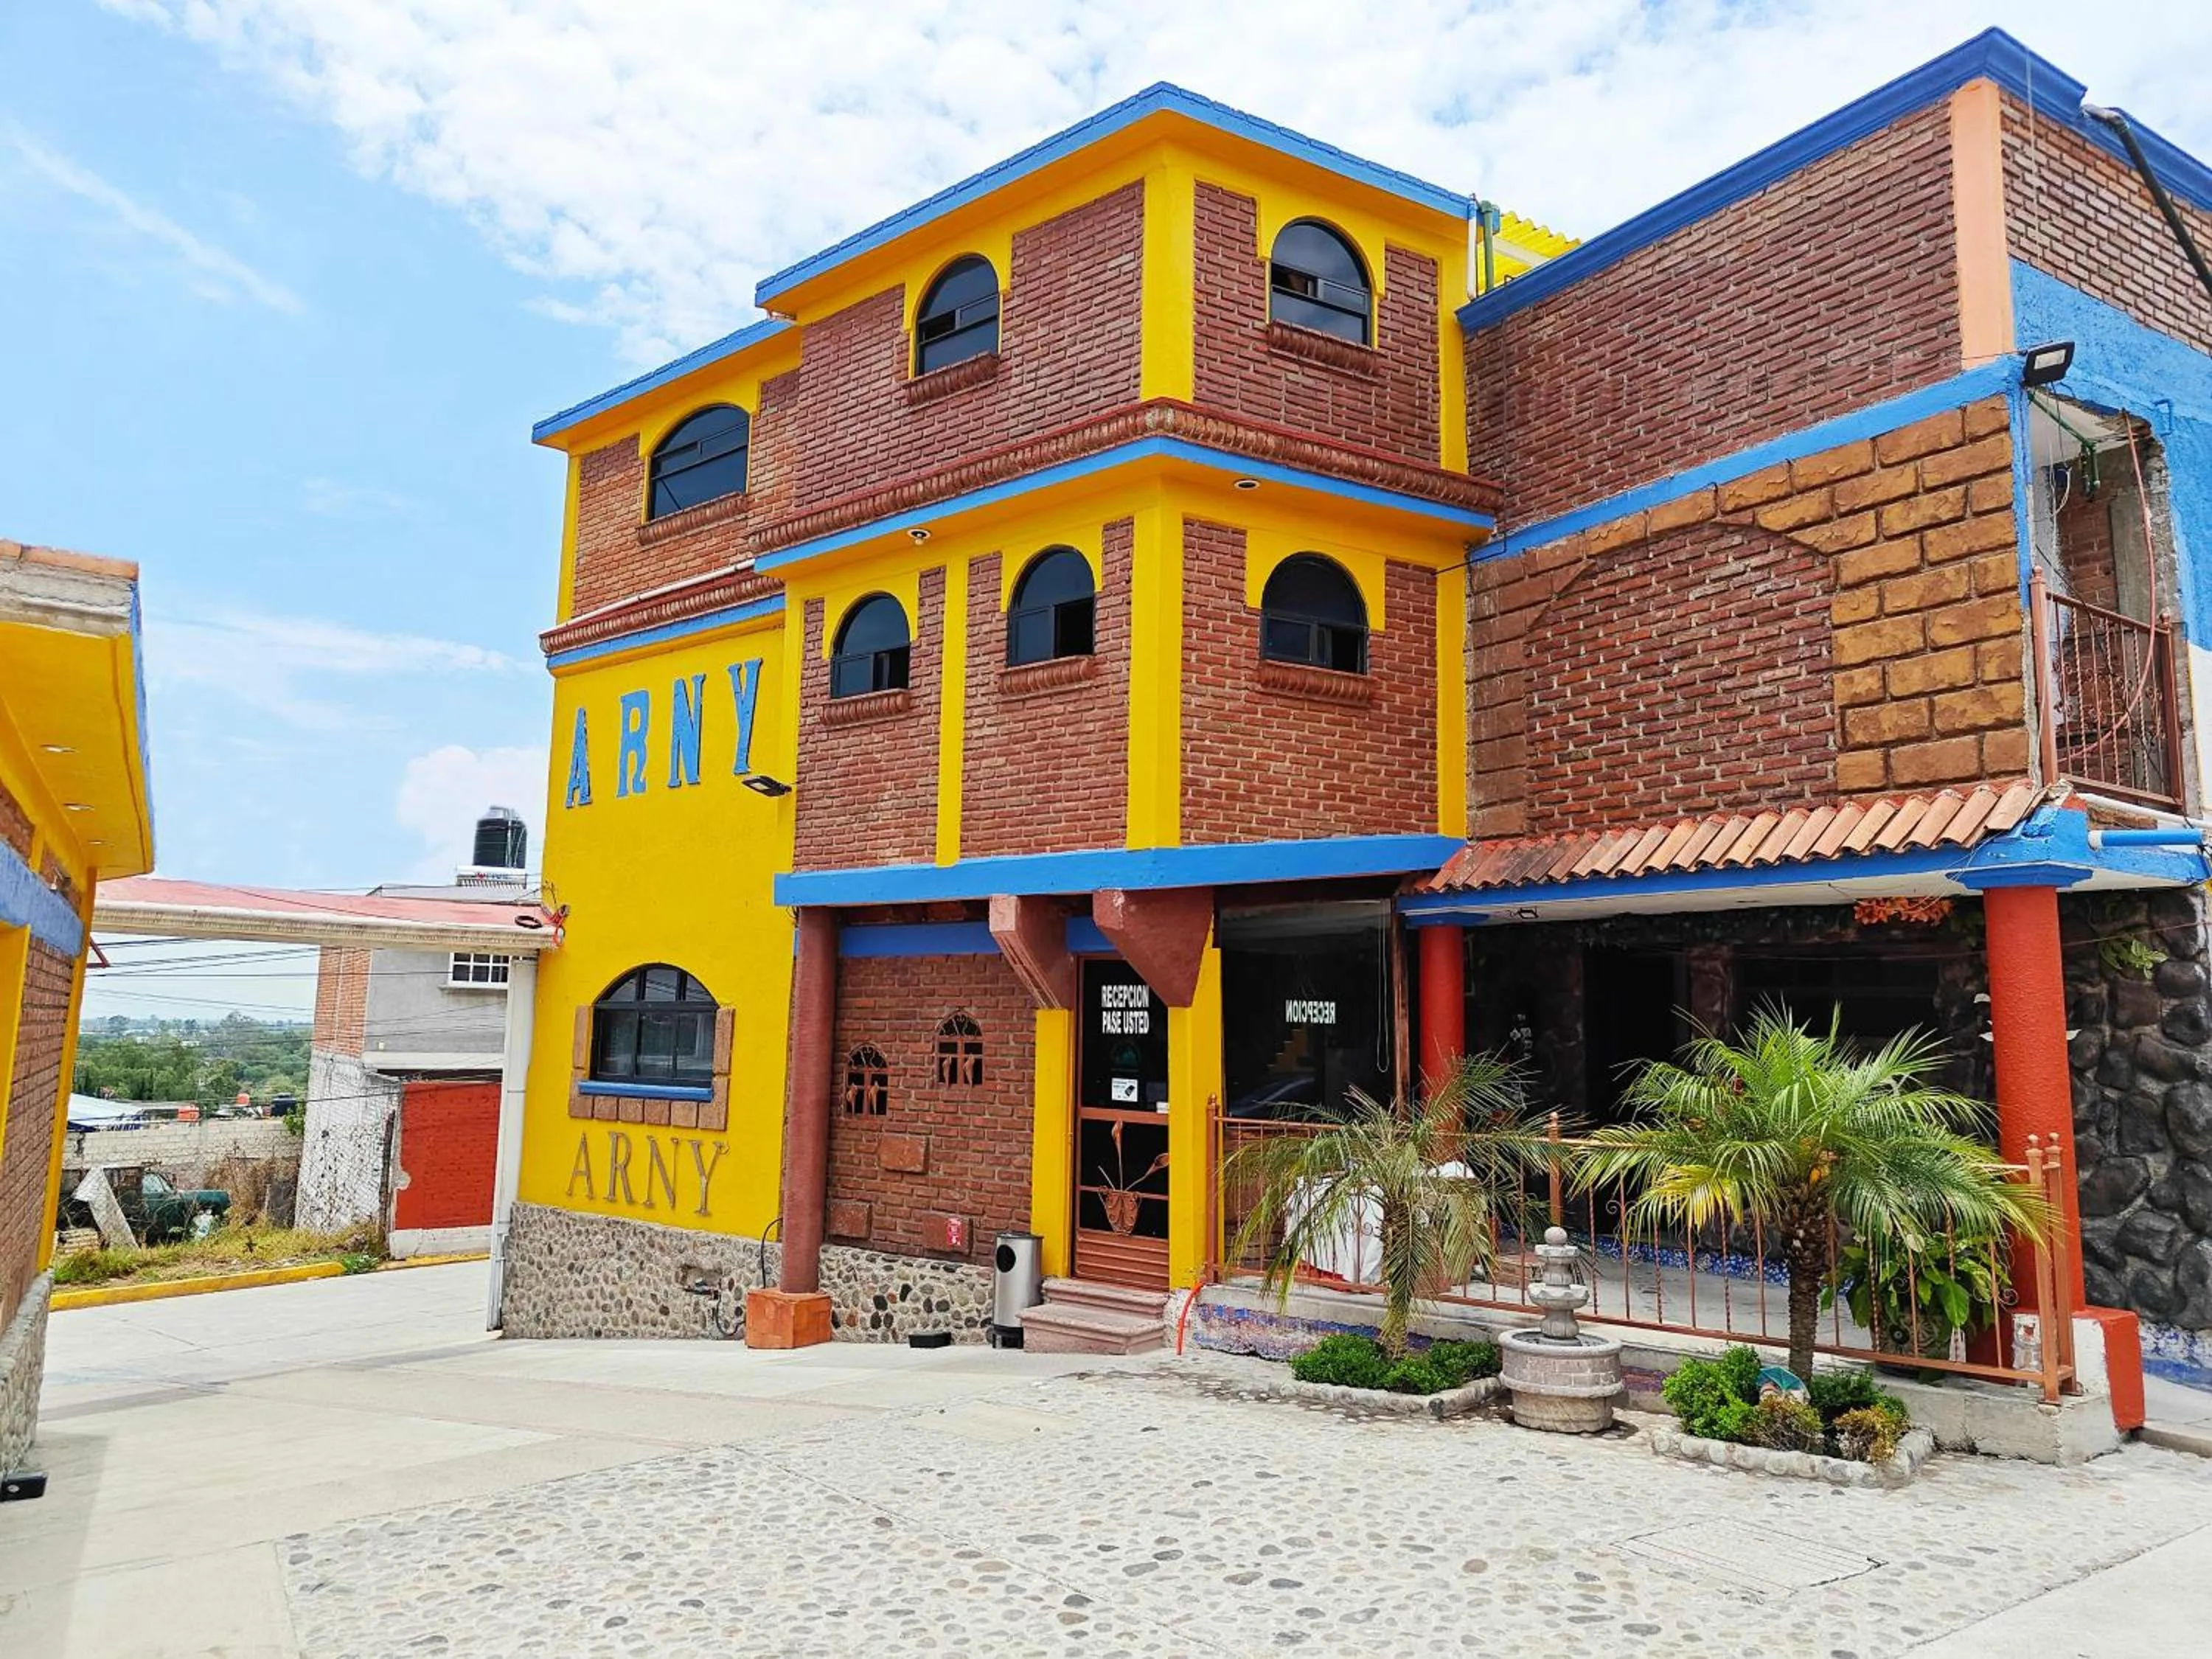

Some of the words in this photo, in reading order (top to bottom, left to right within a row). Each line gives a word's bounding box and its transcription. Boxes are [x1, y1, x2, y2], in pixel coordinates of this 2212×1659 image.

[566, 658, 762, 808] ARNY
[1102, 984, 1150, 1007] RECEPCION
[1102, 1011, 1121, 1034] PASE
[1123, 1011, 1150, 1034] USTED
[566, 1130, 730, 1217] ARNY
